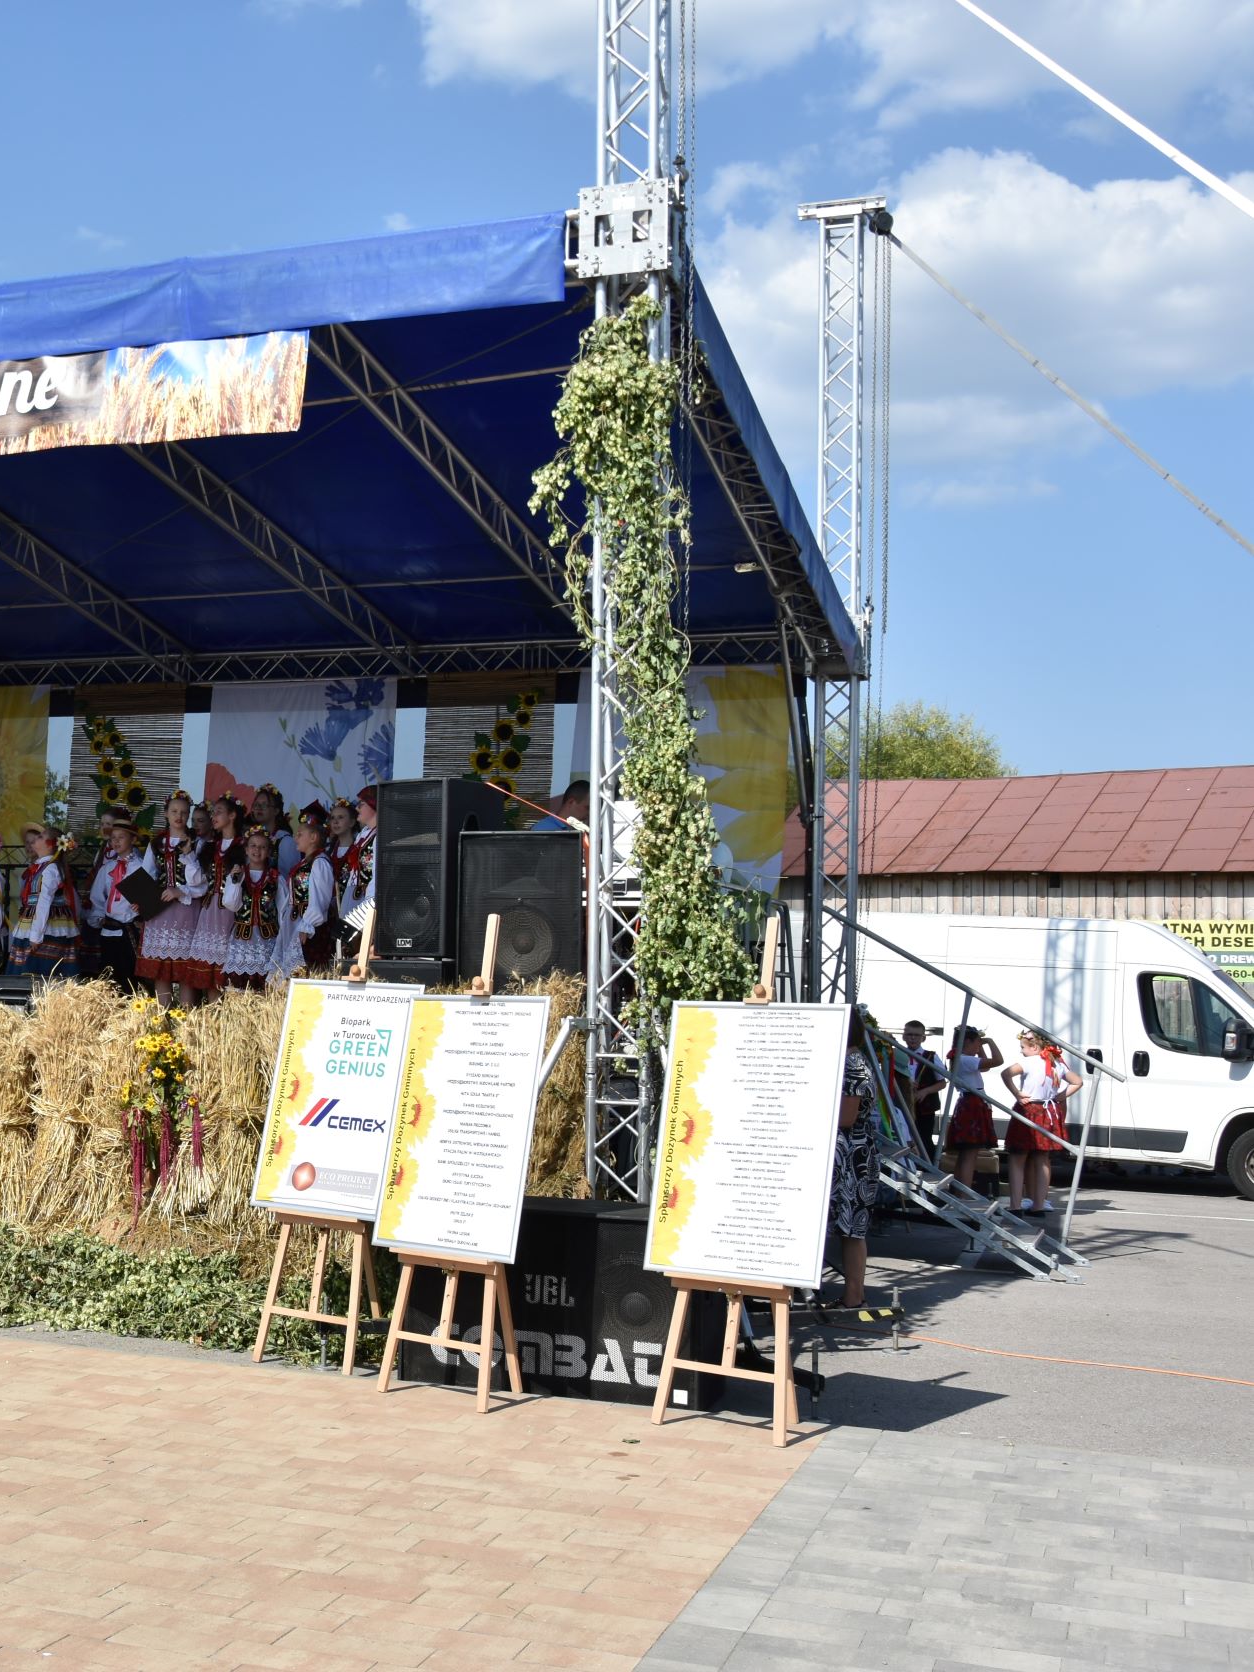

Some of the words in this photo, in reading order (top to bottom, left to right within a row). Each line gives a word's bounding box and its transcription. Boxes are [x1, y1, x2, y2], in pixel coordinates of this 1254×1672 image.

[1211, 937, 1254, 947] DESE
[327, 993, 364, 1002] PARTNERZY
[366, 995, 410, 1004] WYDARZENIA
[340, 1017, 371, 1027] Biopark
[342, 1030, 376, 1040] Turowcu
[329, 1036, 391, 1057] GREEN
[326, 1059, 386, 1078] GENIUS
[671, 1060, 684, 1114] Gminnych
[266, 1120, 281, 1167] Sponsorzy
[275, 1077, 287, 1116] Dożynek
[282, 1029, 295, 1075] Gminnych
[328, 1115, 386, 1133] CEMEX
[387, 1147, 402, 1200] Sponsorzy
[395, 1101, 408, 1143] Dożynek
[402, 1048, 416, 1099] Gminnych
[665, 1117, 678, 1163] Dożynek
[319, 1172, 336, 1180] ECO
[337, 1173, 373, 1185] PROJEKT
[659, 1165, 674, 1223] Sponsorzy
[524, 1273, 574, 1308] JBL
[430, 1323, 663, 1388] COMBAT
